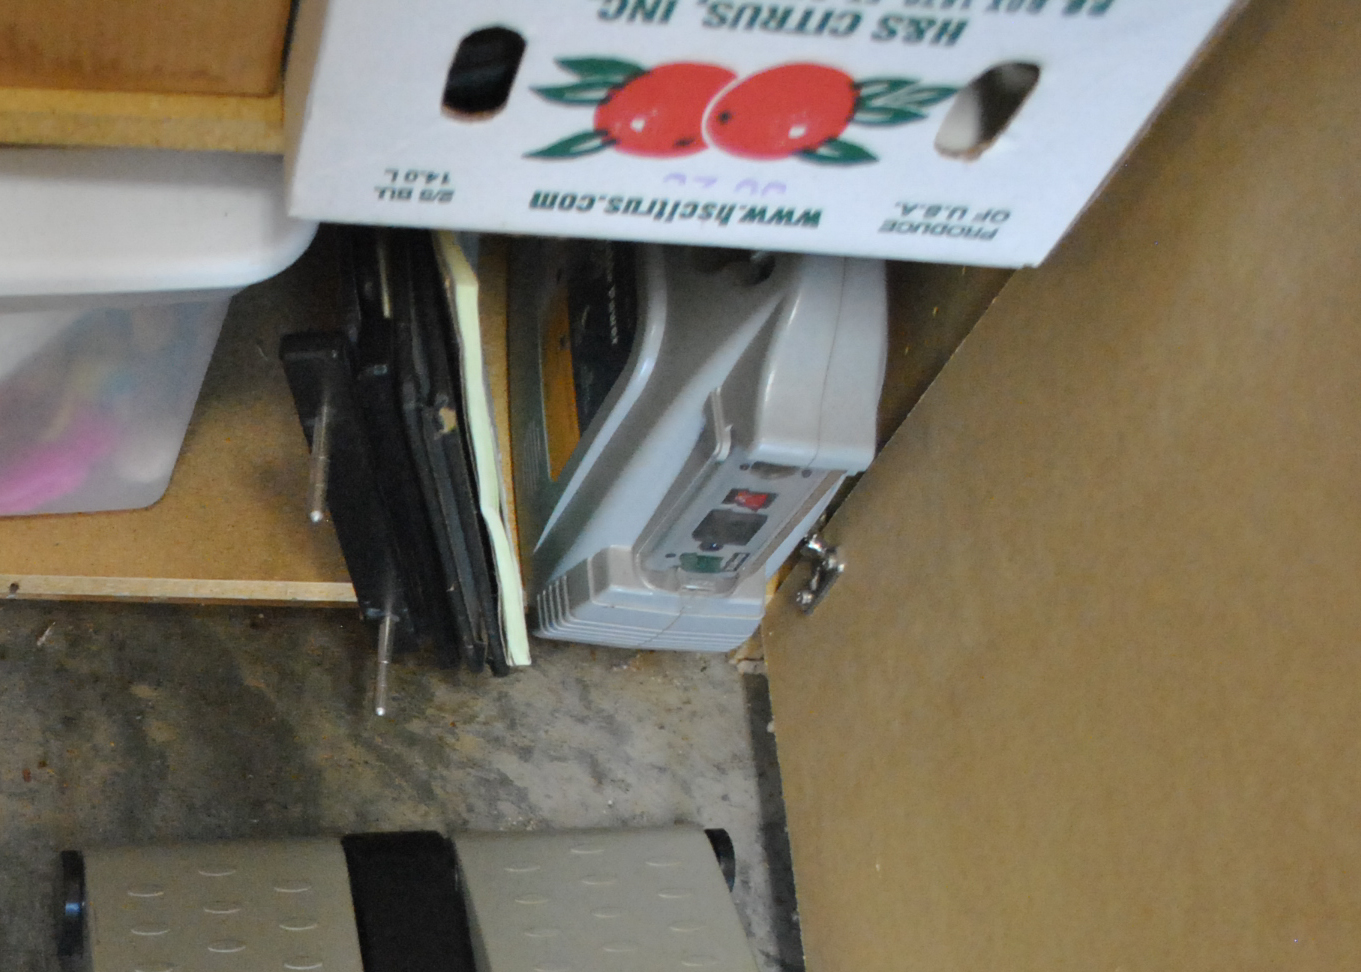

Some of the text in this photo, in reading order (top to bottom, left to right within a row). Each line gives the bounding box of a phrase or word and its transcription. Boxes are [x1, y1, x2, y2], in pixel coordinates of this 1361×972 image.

[587, 0, 679, 25] INC
[697, 0, 864, 38] CITRUS,
[870, 14, 969, 47] H&S
[384, 167, 451, 186] 14.0 L
[528, 189, 823, 229] www.hscitrus.com
[894, 200, 1012, 223] OF U.S.A.
[877, 218, 1000, 242] PRODUCE
